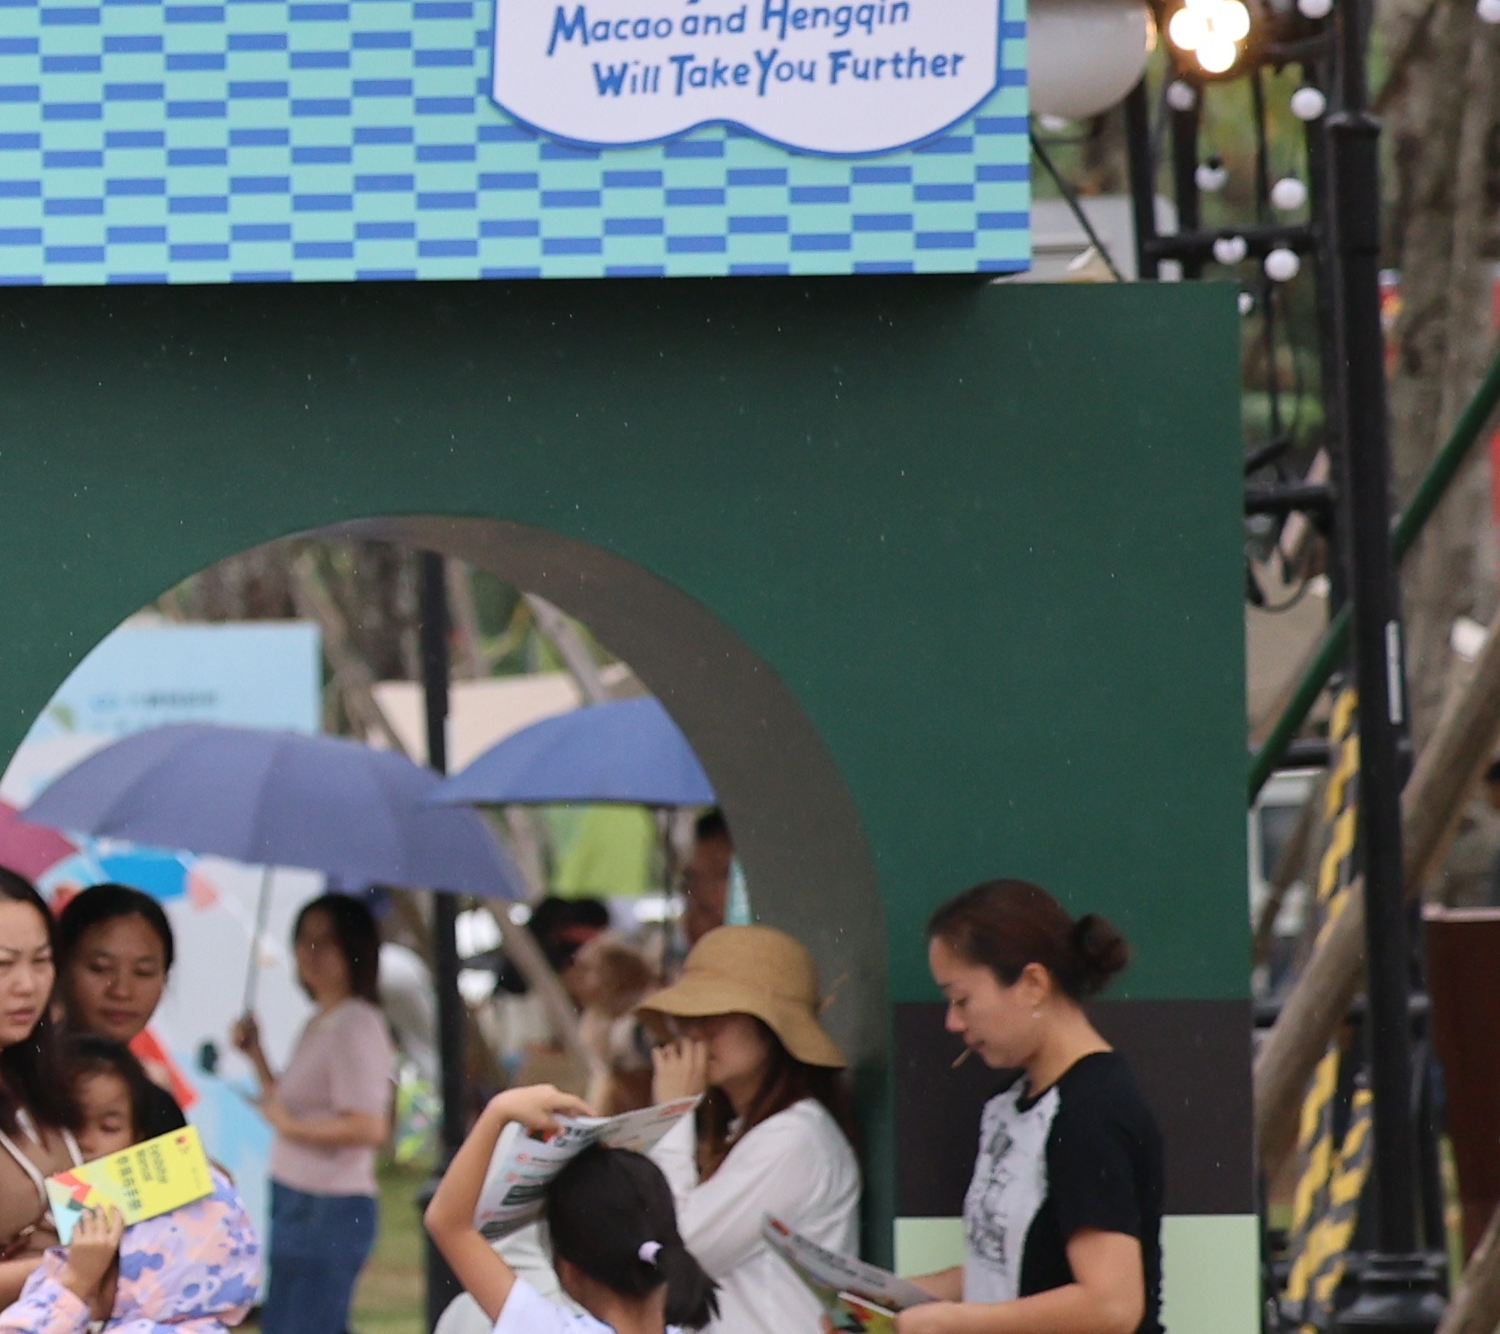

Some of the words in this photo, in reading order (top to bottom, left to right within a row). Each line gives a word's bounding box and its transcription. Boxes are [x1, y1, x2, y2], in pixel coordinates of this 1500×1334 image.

[546, 5, 673, 57] Macao
[681, 5, 748, 36] and
[592, 60, 660, 97] Will
[668, 54, 750, 97] Take
[754, 48, 817, 97] You
[828, 48, 966, 85] Further
